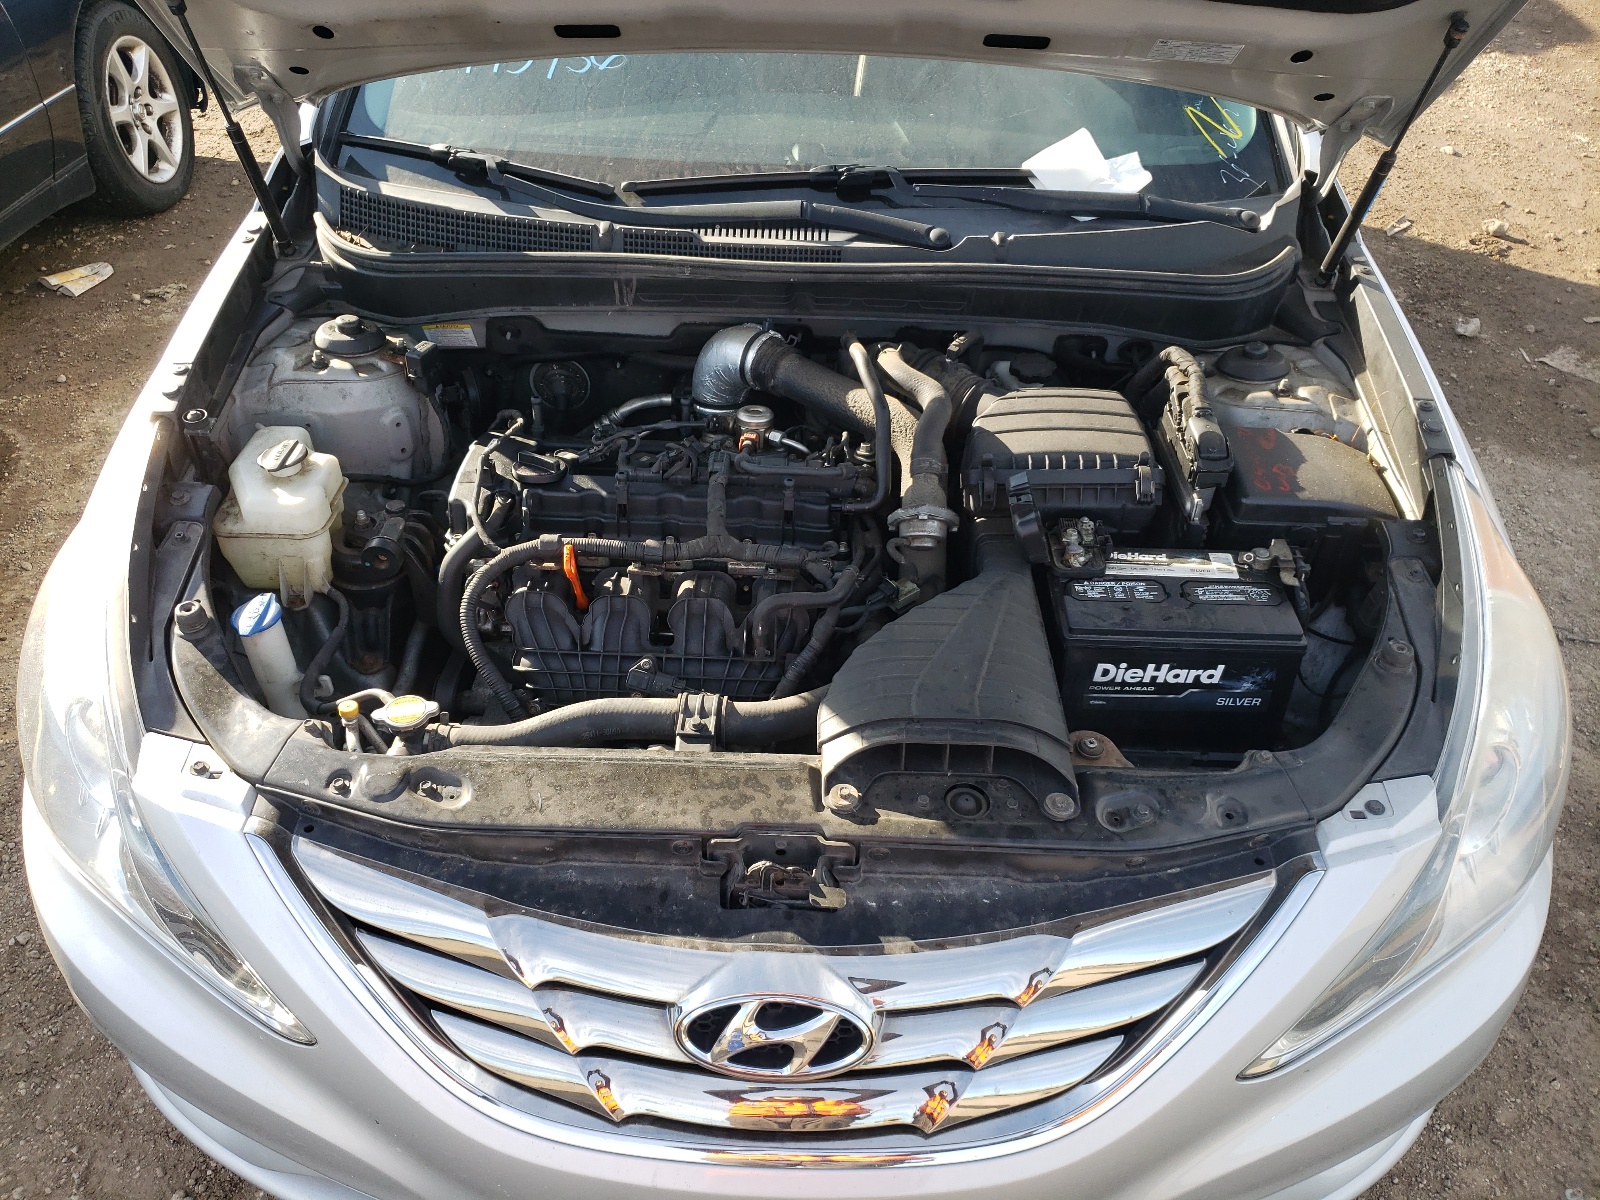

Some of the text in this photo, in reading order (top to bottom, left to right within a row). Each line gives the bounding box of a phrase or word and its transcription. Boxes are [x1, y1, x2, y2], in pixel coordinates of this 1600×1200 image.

[1109, 551, 1167, 561] ieHard
[1092, 662, 1226, 684] DieHard
[1215, 697, 1262, 706] SILVER
